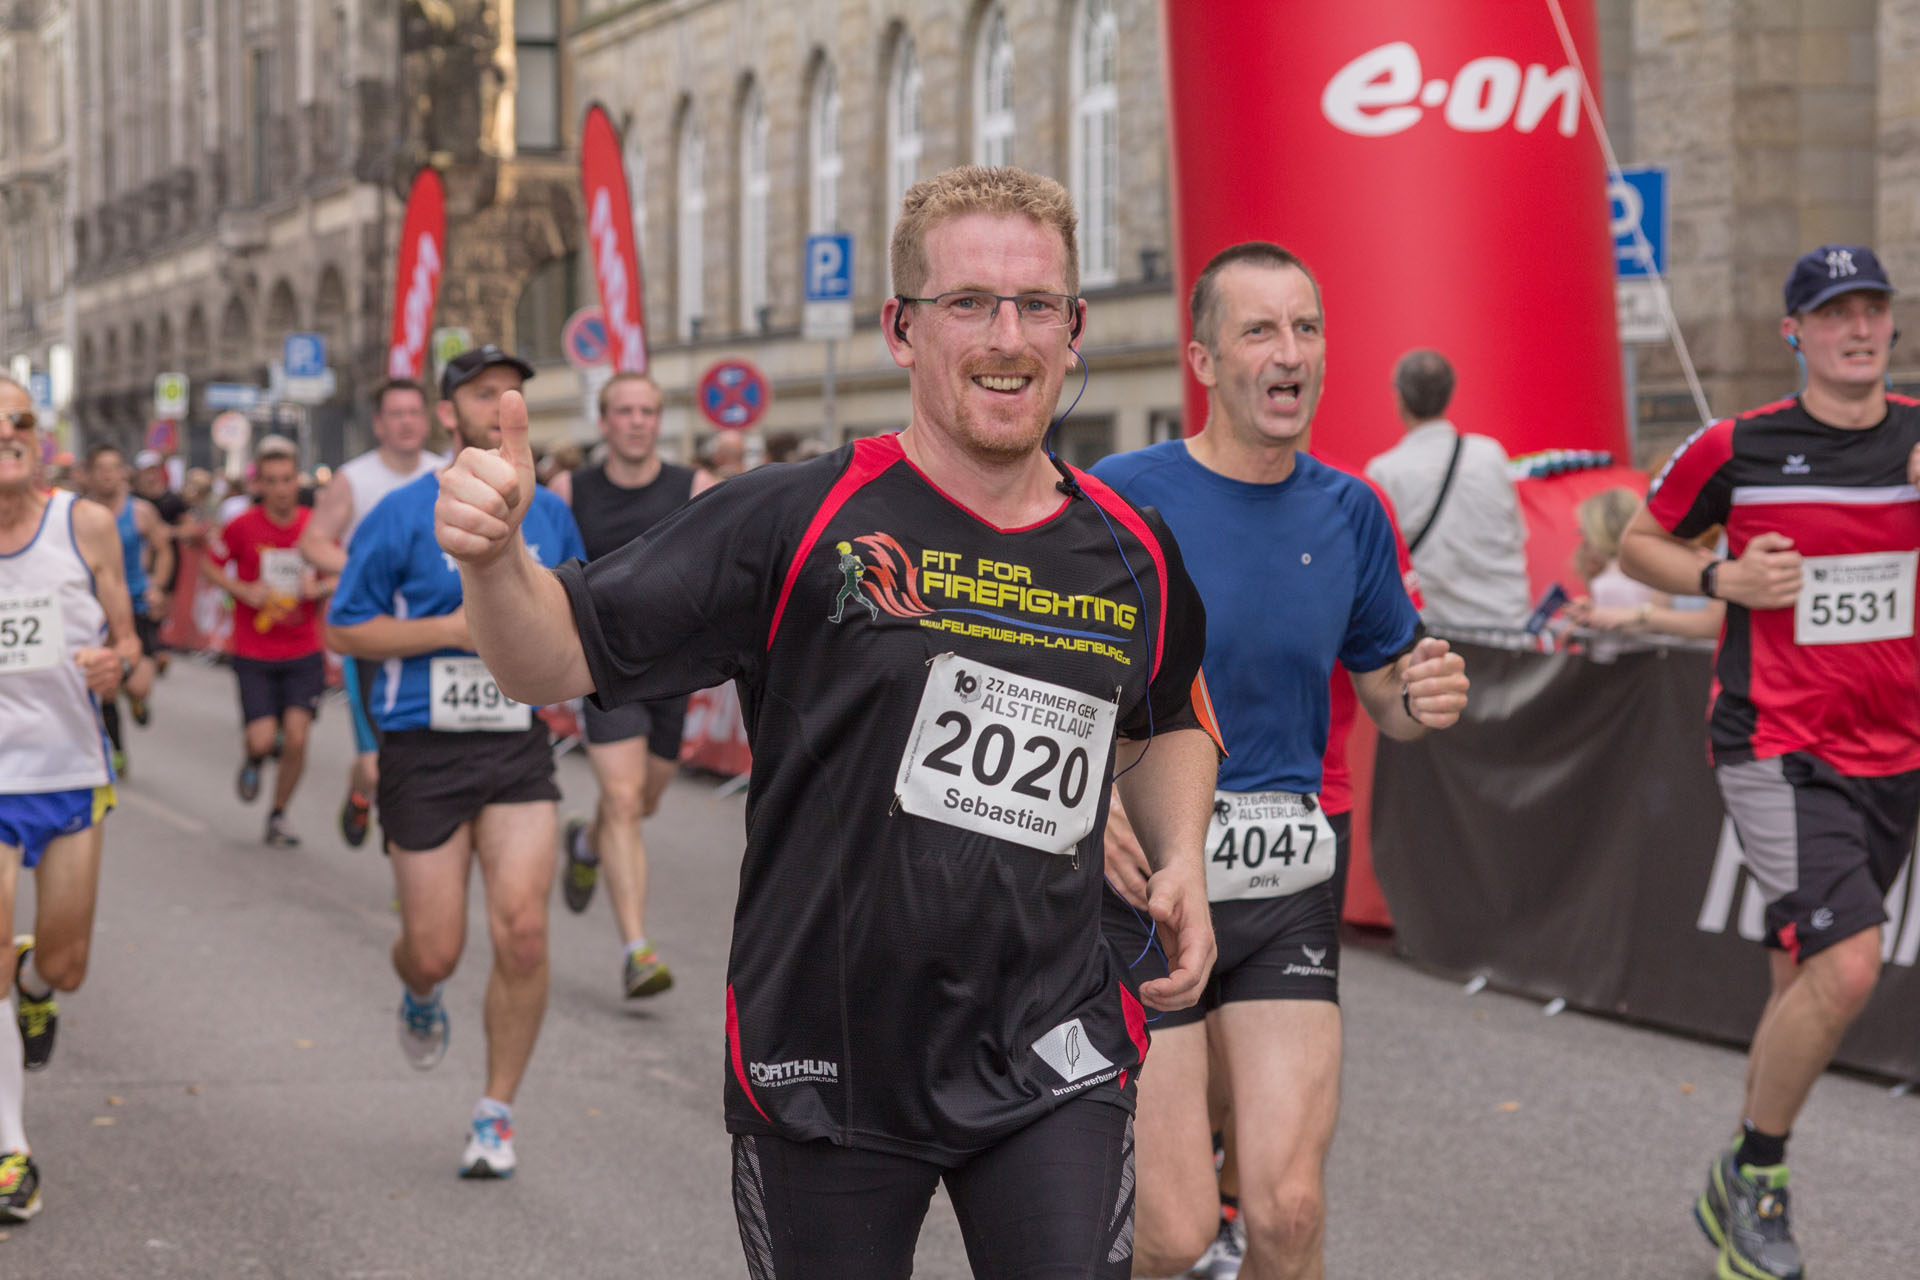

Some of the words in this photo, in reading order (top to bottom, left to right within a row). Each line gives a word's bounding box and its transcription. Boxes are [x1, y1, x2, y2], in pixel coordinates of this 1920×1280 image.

[811, 241, 842, 295] P
[922, 549, 961, 572] FIT
[978, 558, 1032, 584] FOR
[923, 570, 1138, 630] FIREFIGHTING
[1811, 587, 1896, 626] 5531
[1, 617, 41, 648] 52
[980, 694, 1095, 740] ALSTERLAUF
[986, 677, 1005, 694] 27.
[1006, 683, 1077, 713] BARMER
[1077, 703, 1098, 721] GEK
[922, 710, 1089, 809] 2020
[944, 787, 1058, 837] Sebastian
[1212, 823, 1318, 869] 4047
[1249, 874, 1280, 889] Dirk
[749, 1059, 838, 1082] PORTHUN
